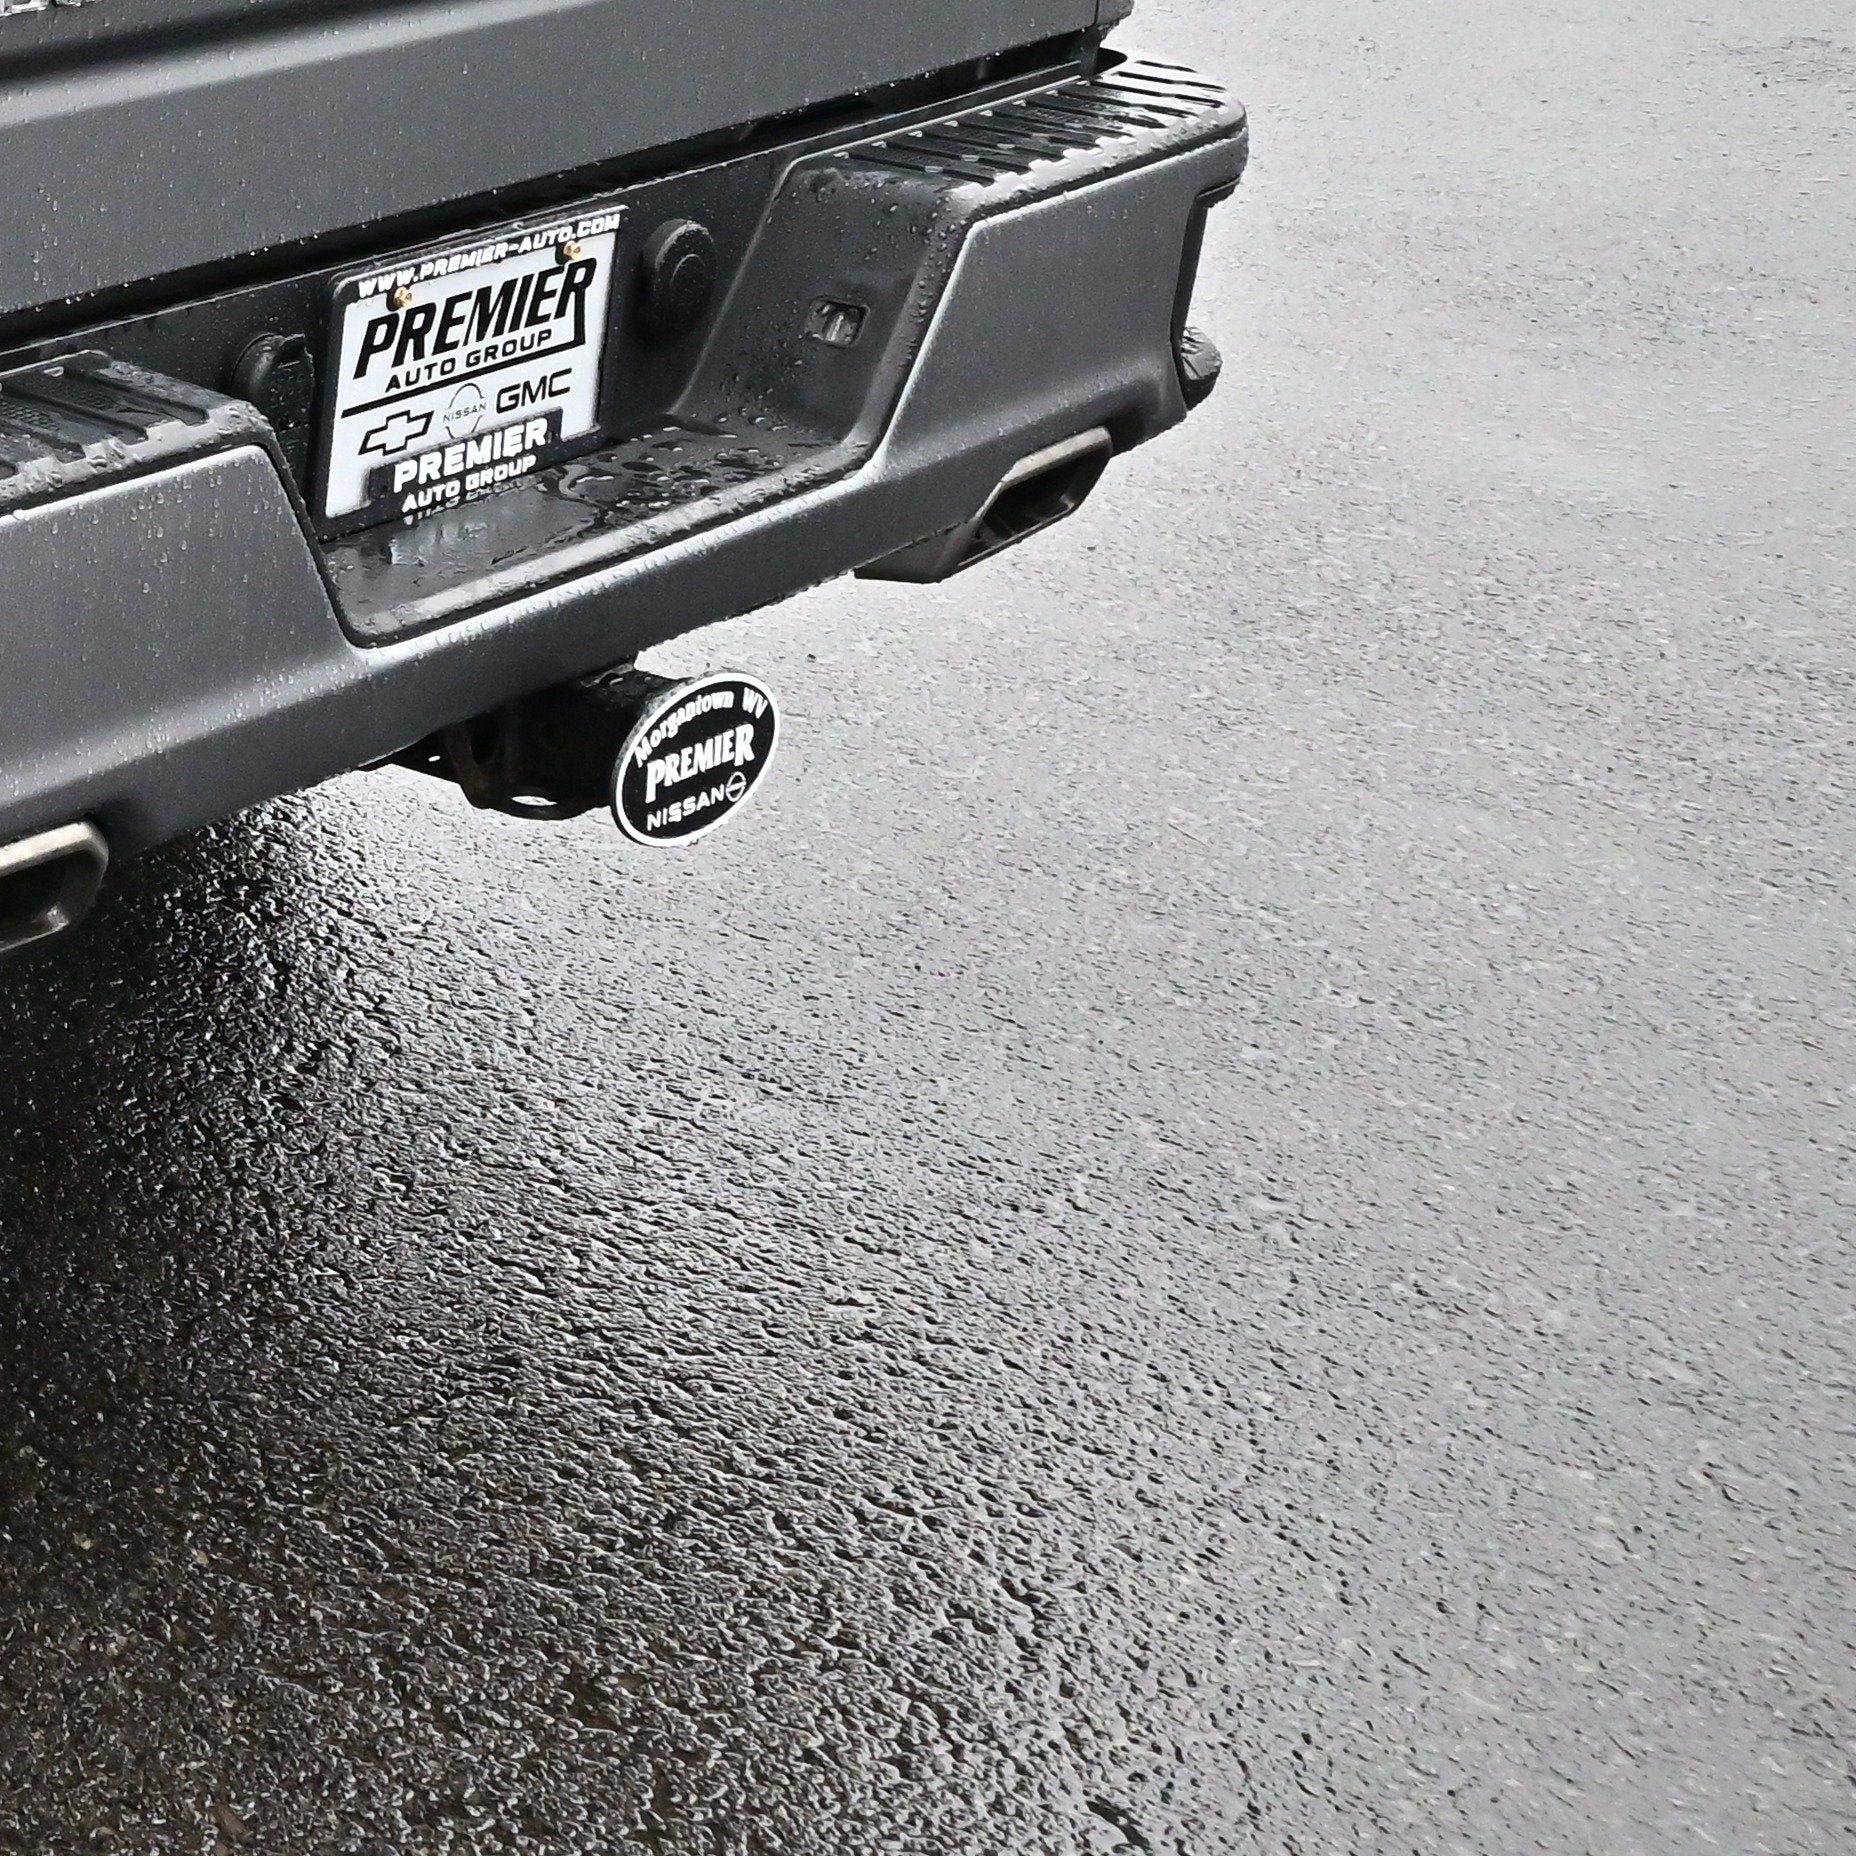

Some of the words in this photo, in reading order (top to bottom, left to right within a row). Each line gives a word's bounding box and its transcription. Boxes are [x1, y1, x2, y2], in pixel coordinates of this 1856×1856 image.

[357, 212, 621, 299] WWW.PREMIER-AUTO.COM
[352, 257, 597, 380] PREMIER
[385, 357, 456, 393] AUTO
[465, 328, 552, 367] GROUP
[495, 367, 572, 414] GMC
[442, 402, 487, 423] NISSAN
[393, 417, 549, 493] PREMIER
[402, 480, 460, 513] AUTO
[465, 454, 536, 488] GROUP
[634, 690, 735, 769] Morgantown
[742, 687, 768, 719] WV
[645, 722, 755, 804] PREMIER
[646, 784, 725, 832] NISSAN
